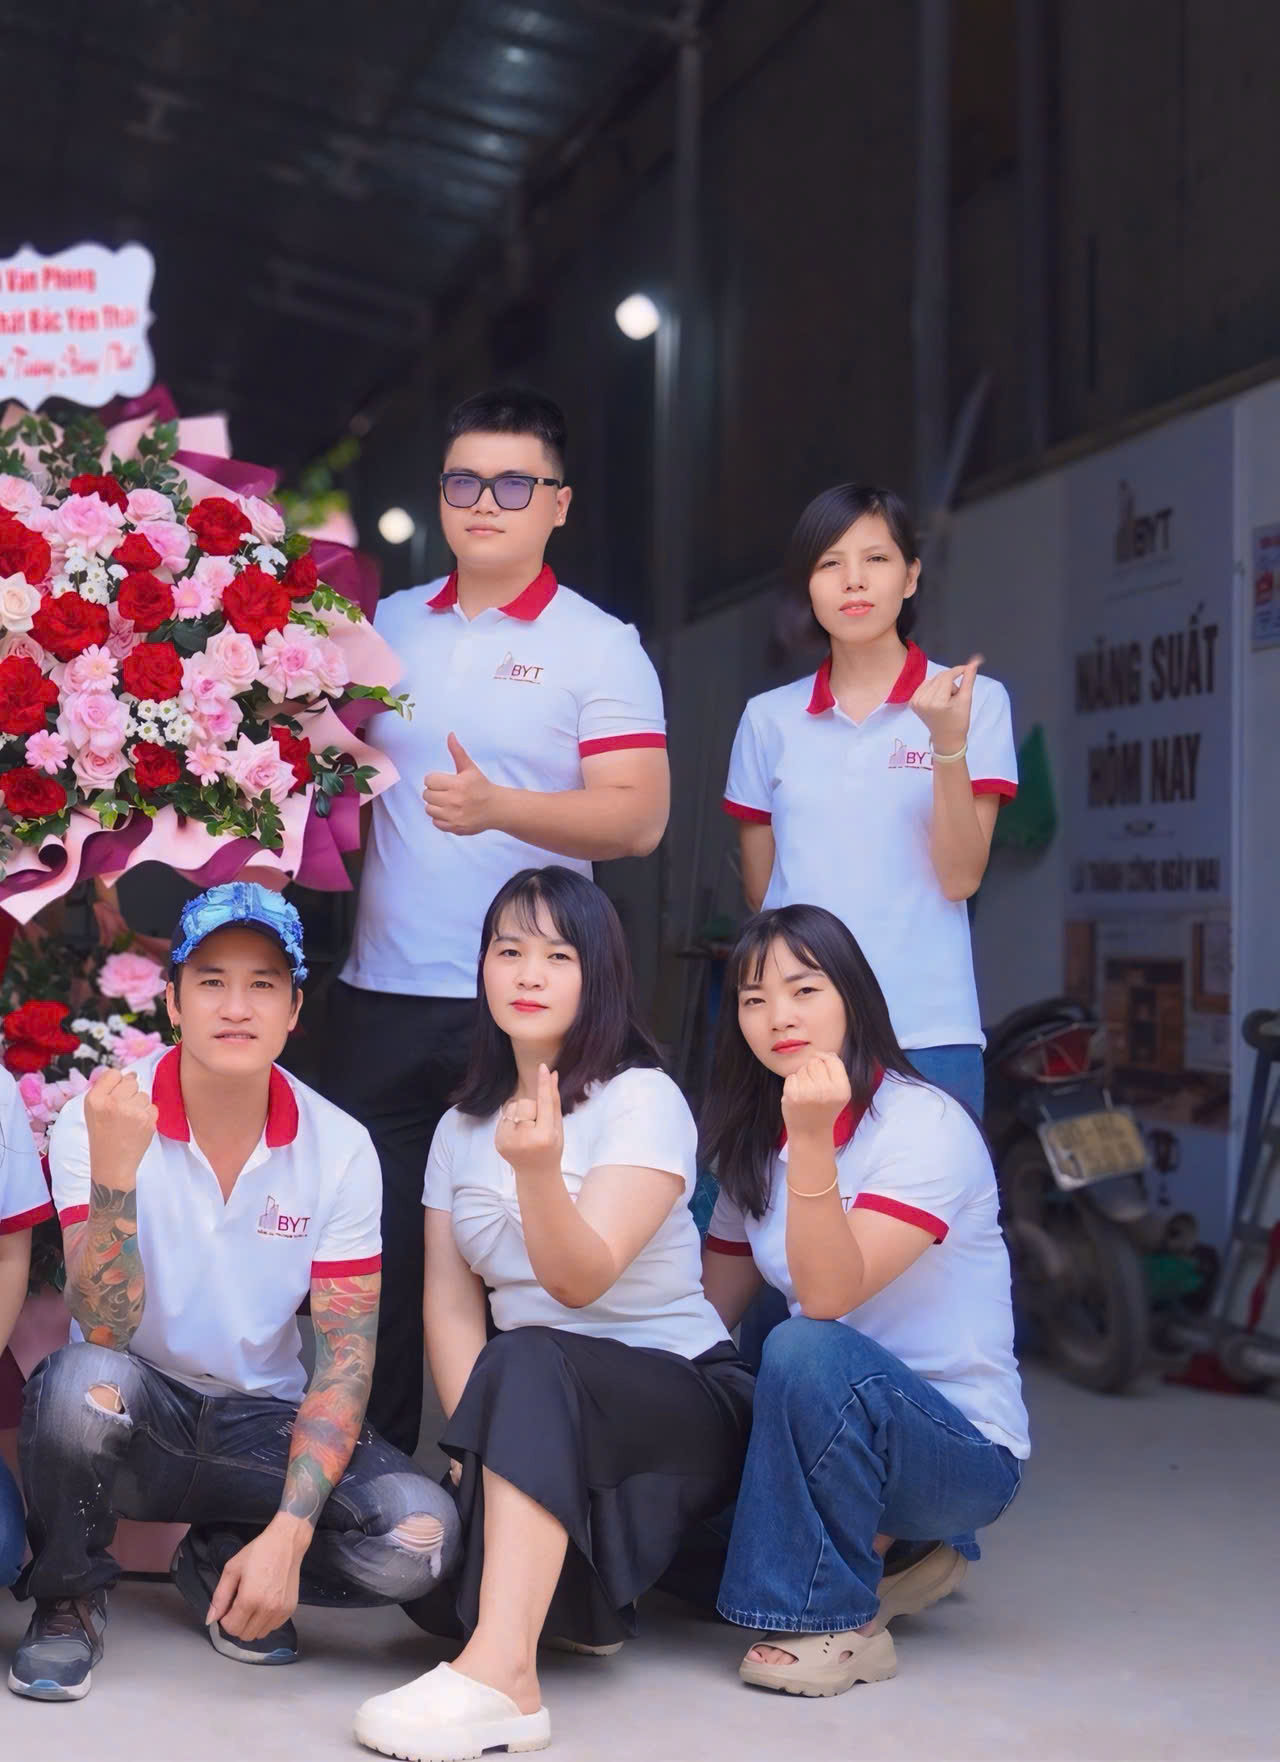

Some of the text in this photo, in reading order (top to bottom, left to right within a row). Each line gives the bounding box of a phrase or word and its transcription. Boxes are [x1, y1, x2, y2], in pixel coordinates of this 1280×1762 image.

[511, 664, 545, 680] BYT
[1149, 731, 1202, 804] NAY
[278, 1215, 311, 1233] BYT
